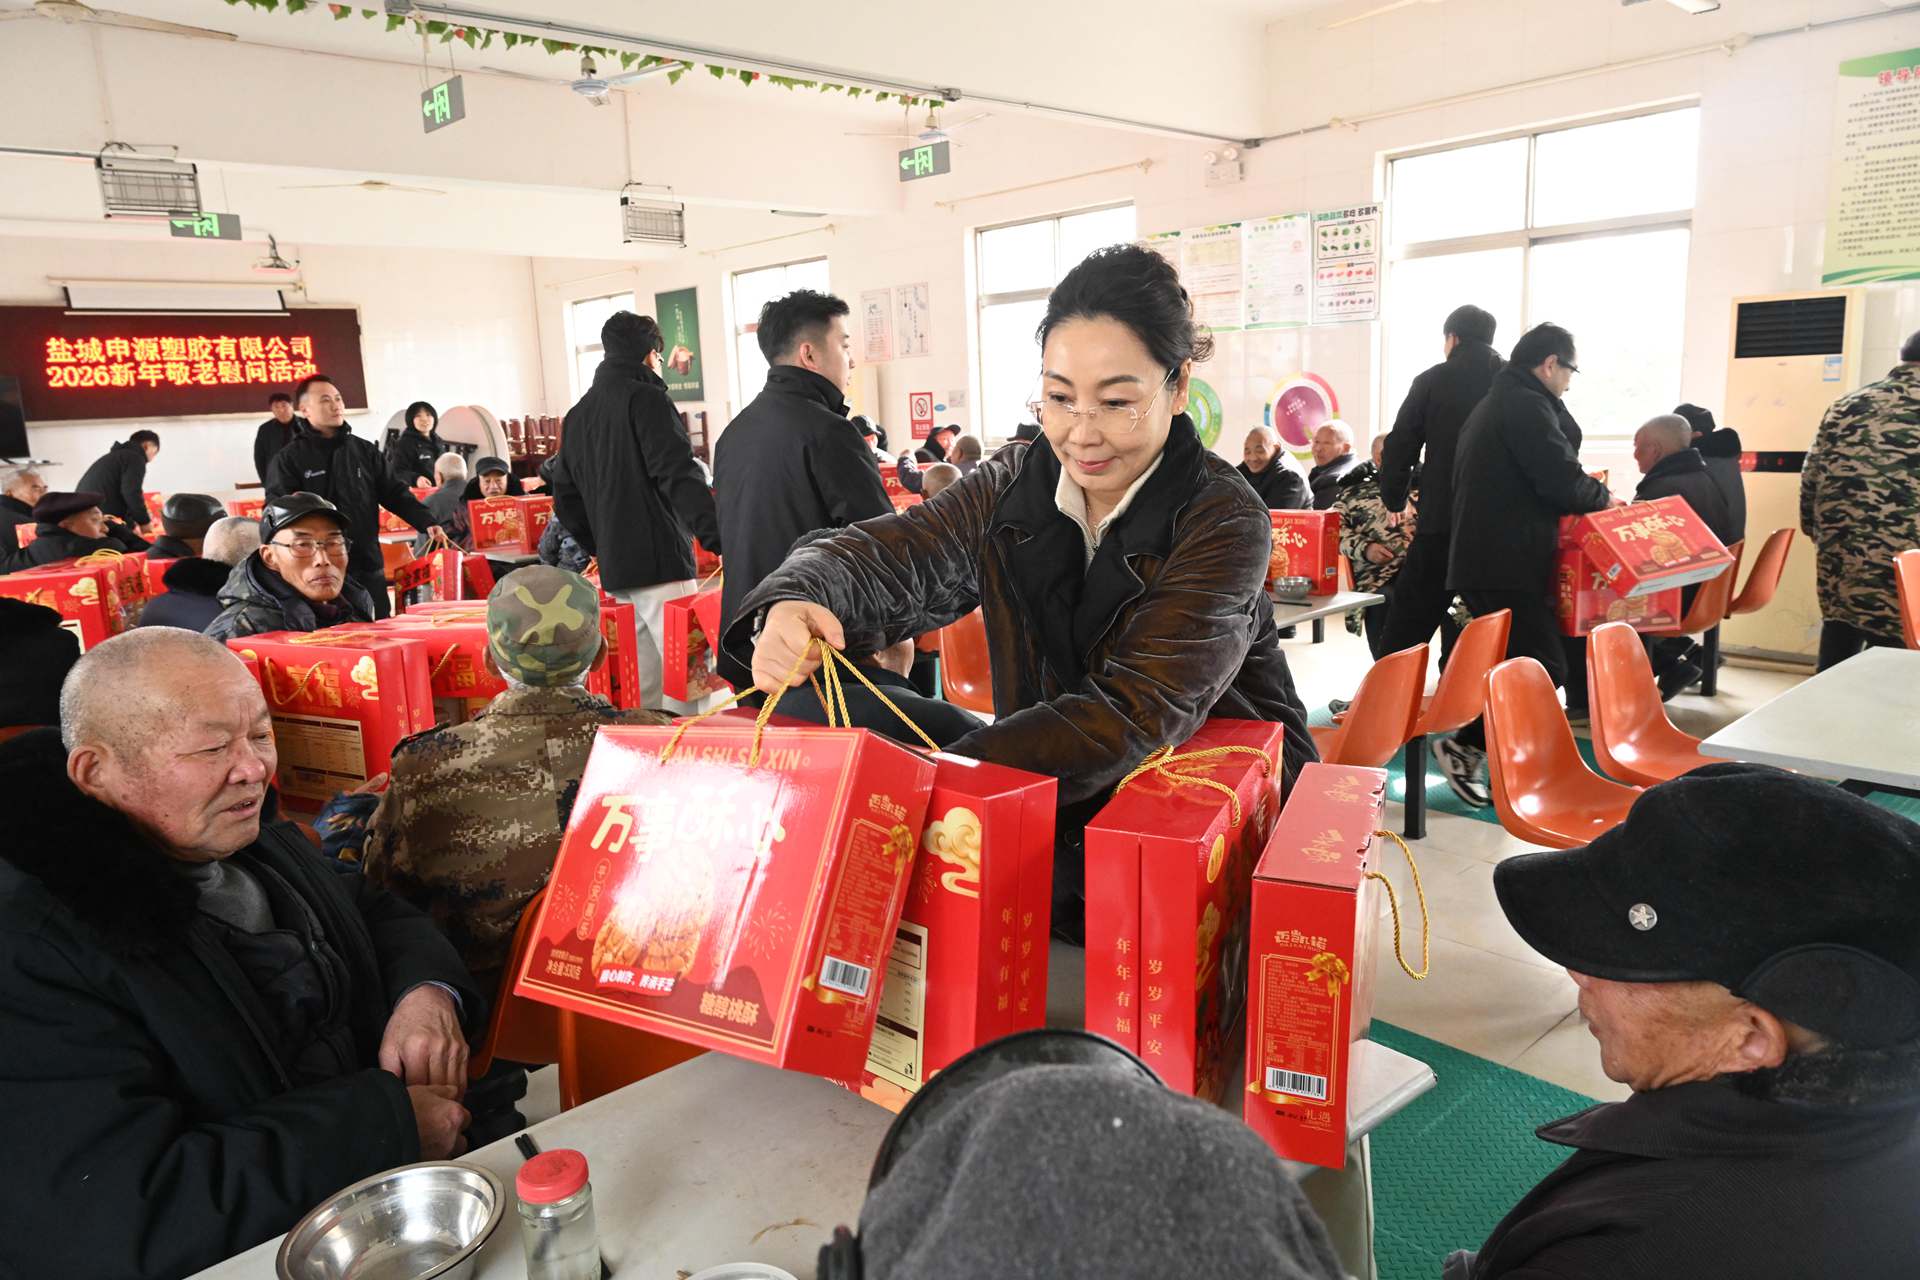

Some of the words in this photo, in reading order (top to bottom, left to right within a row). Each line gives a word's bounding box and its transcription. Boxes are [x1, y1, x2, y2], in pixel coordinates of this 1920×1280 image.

[46, 336, 313, 363] 盐城申源塑胶有限公司
[47, 360, 317, 388] 2026新年敬老慰问活动
[702, 746, 732, 764] SHI
[764, 748, 802, 771] XIN
[997, 907, 1013, 1012] 年年有福
[1018, 911, 1033, 1014] 岁岁平安
[1116, 937, 1132, 1034] 年年有福
[1147, 959, 1163, 1056] 岁岁平安
